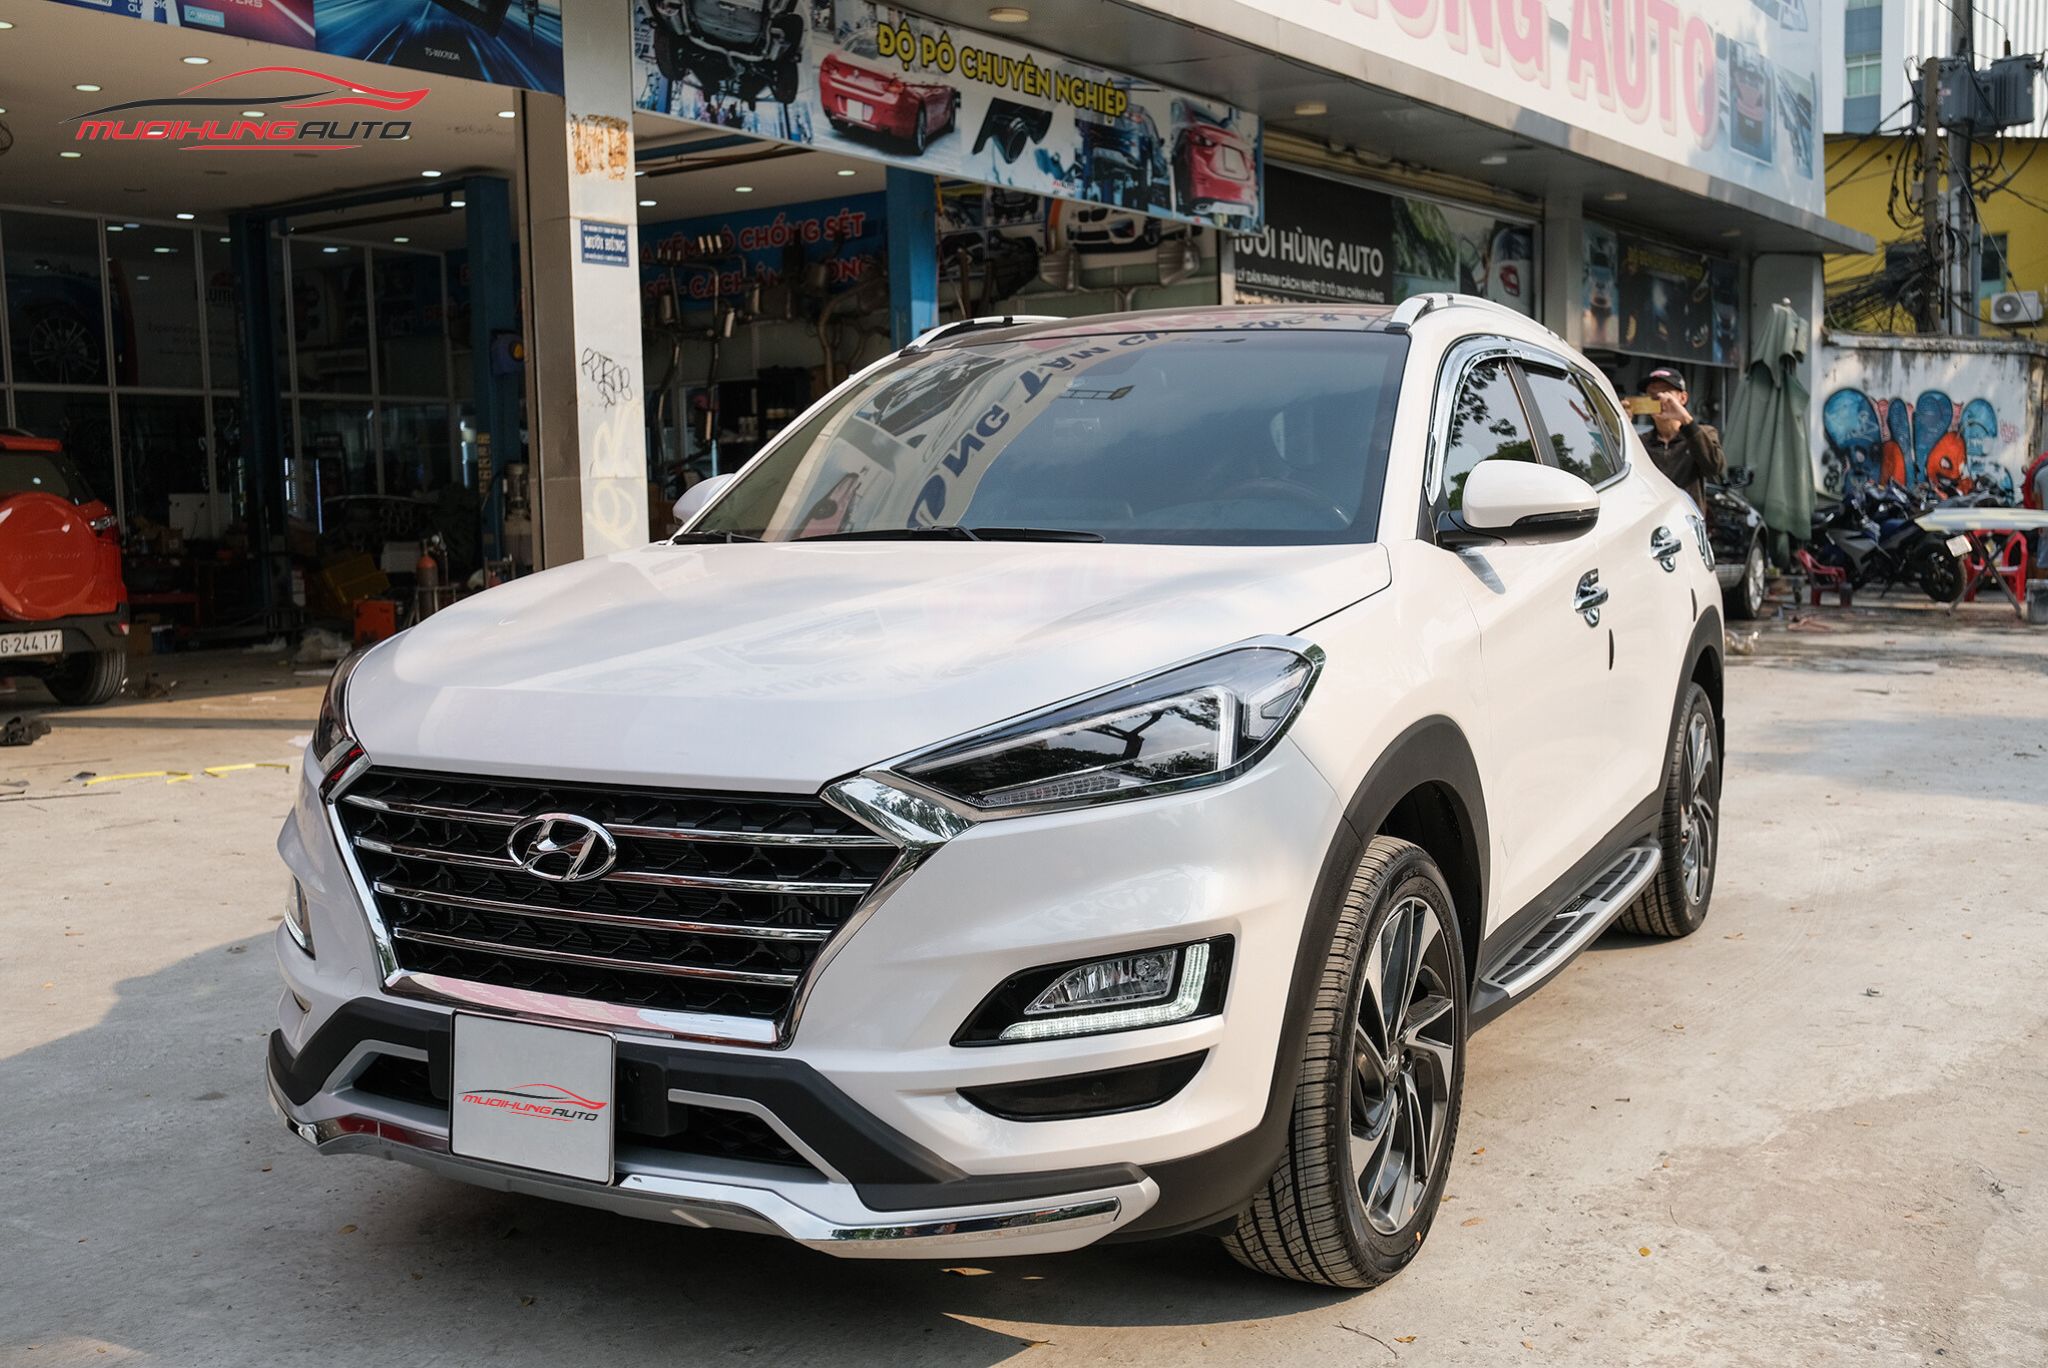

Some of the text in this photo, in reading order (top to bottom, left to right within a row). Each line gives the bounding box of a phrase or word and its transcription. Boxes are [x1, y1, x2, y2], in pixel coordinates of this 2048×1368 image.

[877, 19, 1128, 125] ĐỘ PÔ CHUYÊN NGHIỆP
[1568, 0, 1718, 151] AUTO
[1280, 226, 1334, 269] HÙNG
[1337, 242, 1384, 277] AUTO
